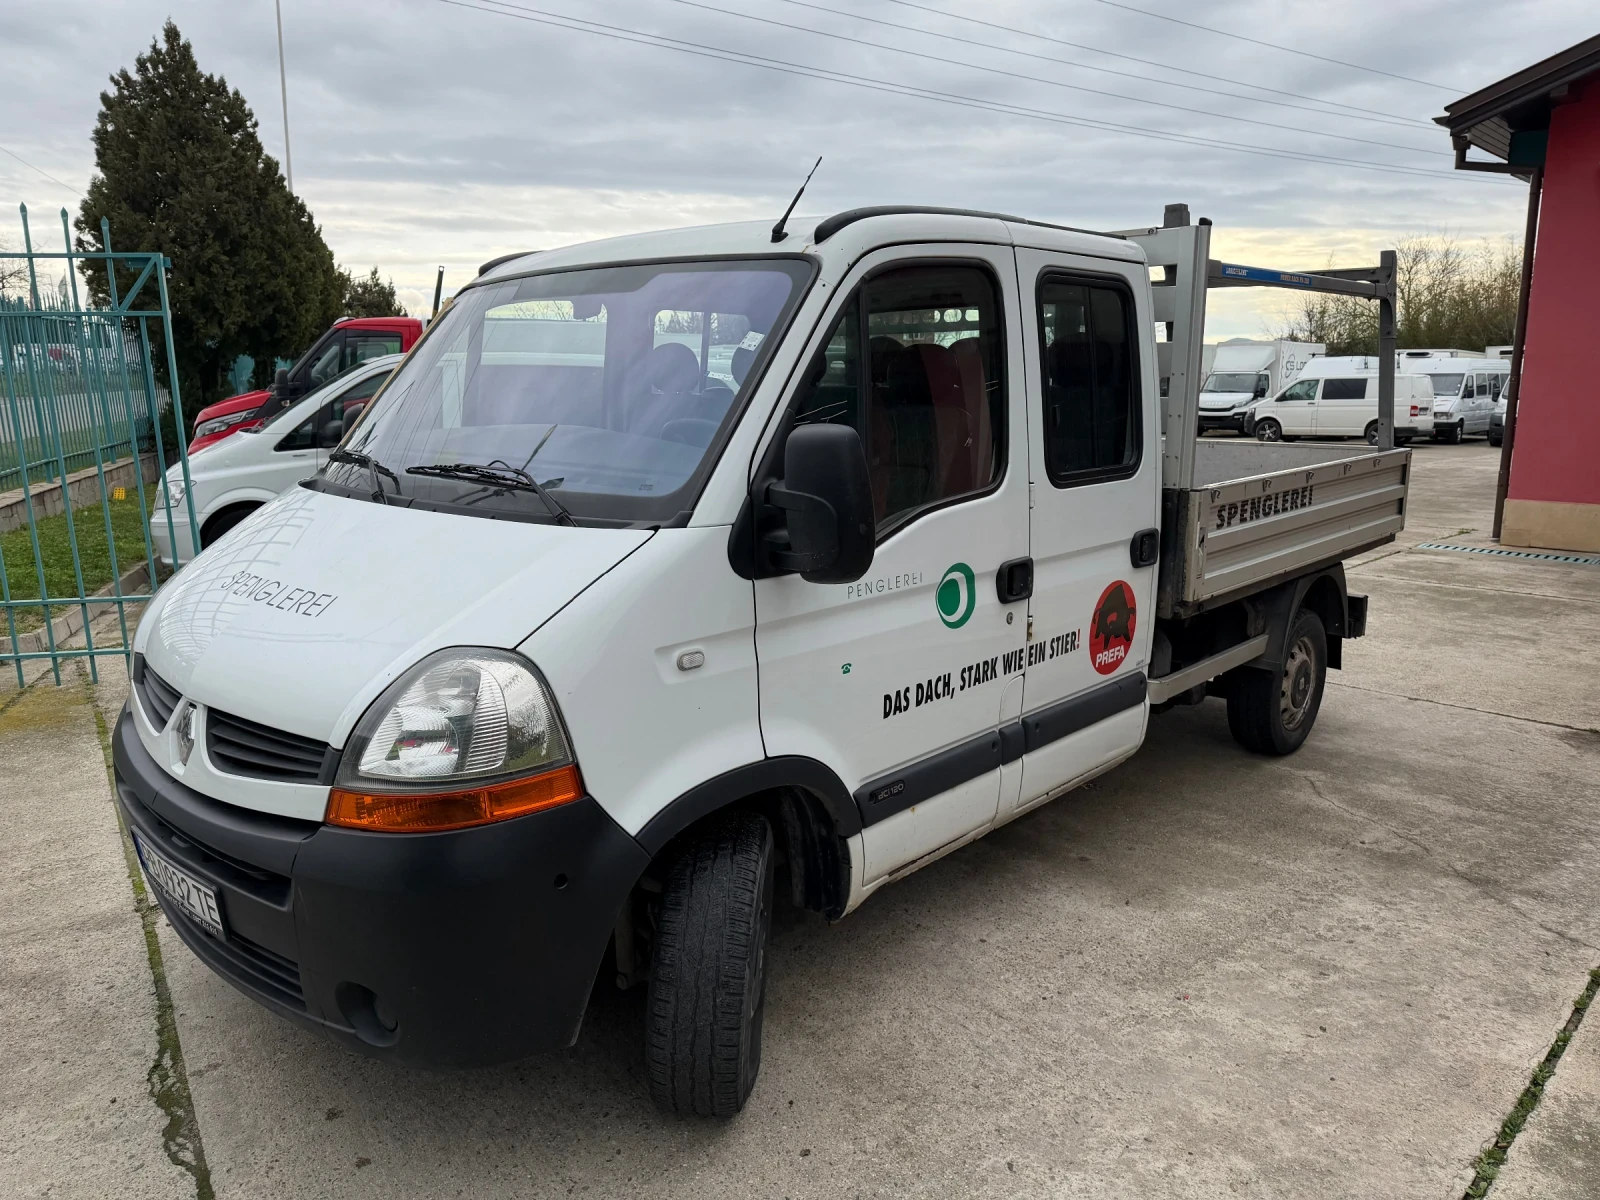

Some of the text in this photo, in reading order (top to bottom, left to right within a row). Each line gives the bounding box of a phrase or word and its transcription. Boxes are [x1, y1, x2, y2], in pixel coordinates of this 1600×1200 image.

[1216, 485, 1314, 530] SPENGLEREI
[220, 570, 338, 618] SPENGLEREI
[847, 572, 923, 600] PENGLEREI
[883, 628, 1081, 720] DAS DACH, STARK WIE EIN STIER!
[1096, 645, 1125, 668] PREFA
